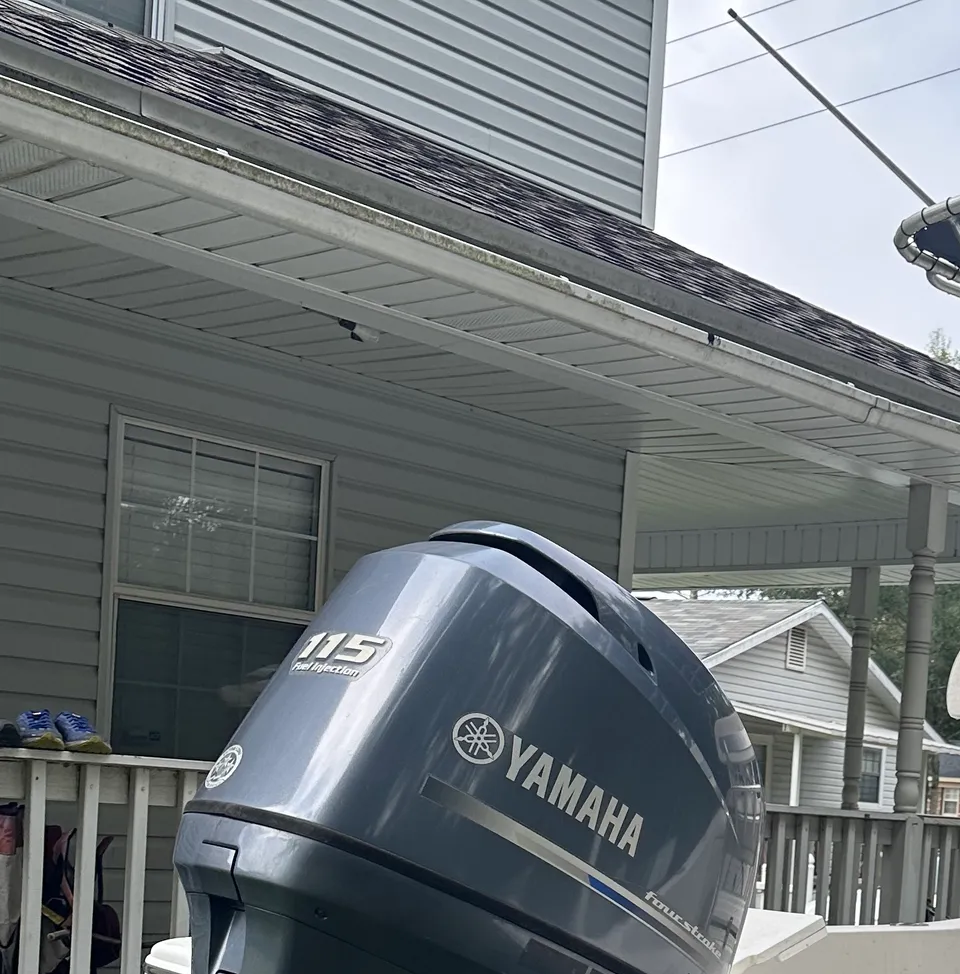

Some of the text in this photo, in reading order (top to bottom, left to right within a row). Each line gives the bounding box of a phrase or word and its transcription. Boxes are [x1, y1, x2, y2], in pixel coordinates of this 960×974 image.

[297, 631, 386, 665] 115
[291, 660, 361, 678] Fuel Injection
[505, 734, 644, 858] YAMAHA
